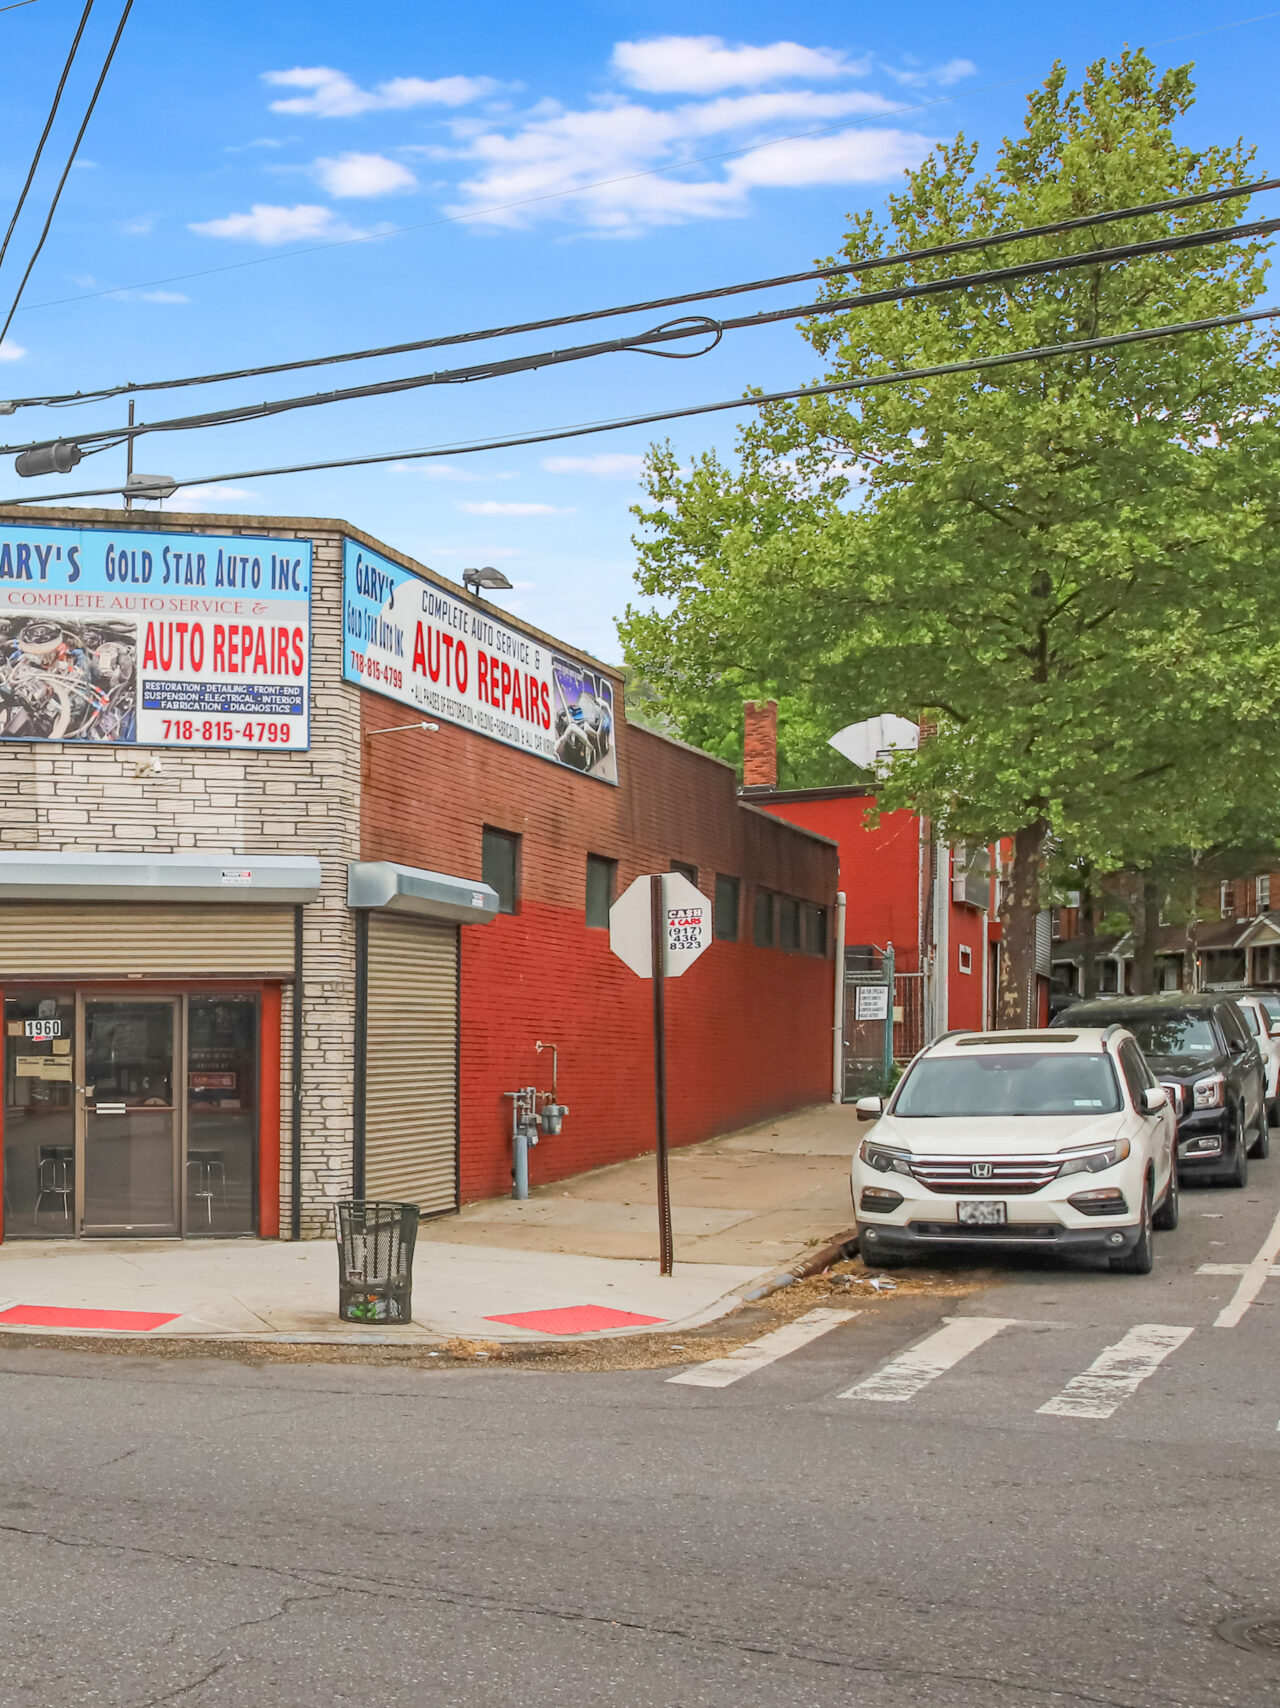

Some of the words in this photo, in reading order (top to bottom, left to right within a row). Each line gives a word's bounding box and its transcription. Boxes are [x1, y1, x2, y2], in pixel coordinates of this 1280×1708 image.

[105, 543, 154, 584] GOLD
[162, 545, 206, 586] STAR
[215, 548, 261, 589] AUTO
[271, 554, 308, 592] INC.
[356, 553, 395, 610] GARY'S
[8, 591, 105, 608] COMPLETE
[110, 596, 165, 611] AUTO
[168, 599, 244, 614] SERVICE
[252, 602, 269, 614] &
[347, 600, 363, 639] GOLD
[364, 607, 378, 647] STAR
[422, 590, 468, 633] COMPLETE
[471, 617, 494, 647] AUTO
[496, 630, 530, 665] SERVICE
[534, 650, 540, 670] &
[141, 621, 205, 672] AUTO
[213, 624, 305, 676] REPAIRS
[351, 650, 403, 689] 718-815-4799
[412, 620, 468, 694] AUTO
[477, 650, 551, 731] REPAIRS
[145, 681, 201, 692] RESTORATION
[206, 684, 247, 693] DETAILING
[254, 685, 300, 695] FRONT-END
[143, 691, 199, 701] SUSPENSION
[204, 693, 255, 703] ELECTRICAL
[262, 695, 302, 705] INTERIOR
[161, 700, 221, 711] FABRICATION
[230, 704, 291, 713] DIAGNOSTICS
[162, 719, 291, 743] 718-815-4799
[668, 908, 702, 919] CASH
[678, 918, 702, 926] CARS
[669, 926, 702, 937] (917)
[673, 934, 698, 942] 436
[670, 941, 702, 950] 8323
[27, 1021, 60, 1036] 1960
